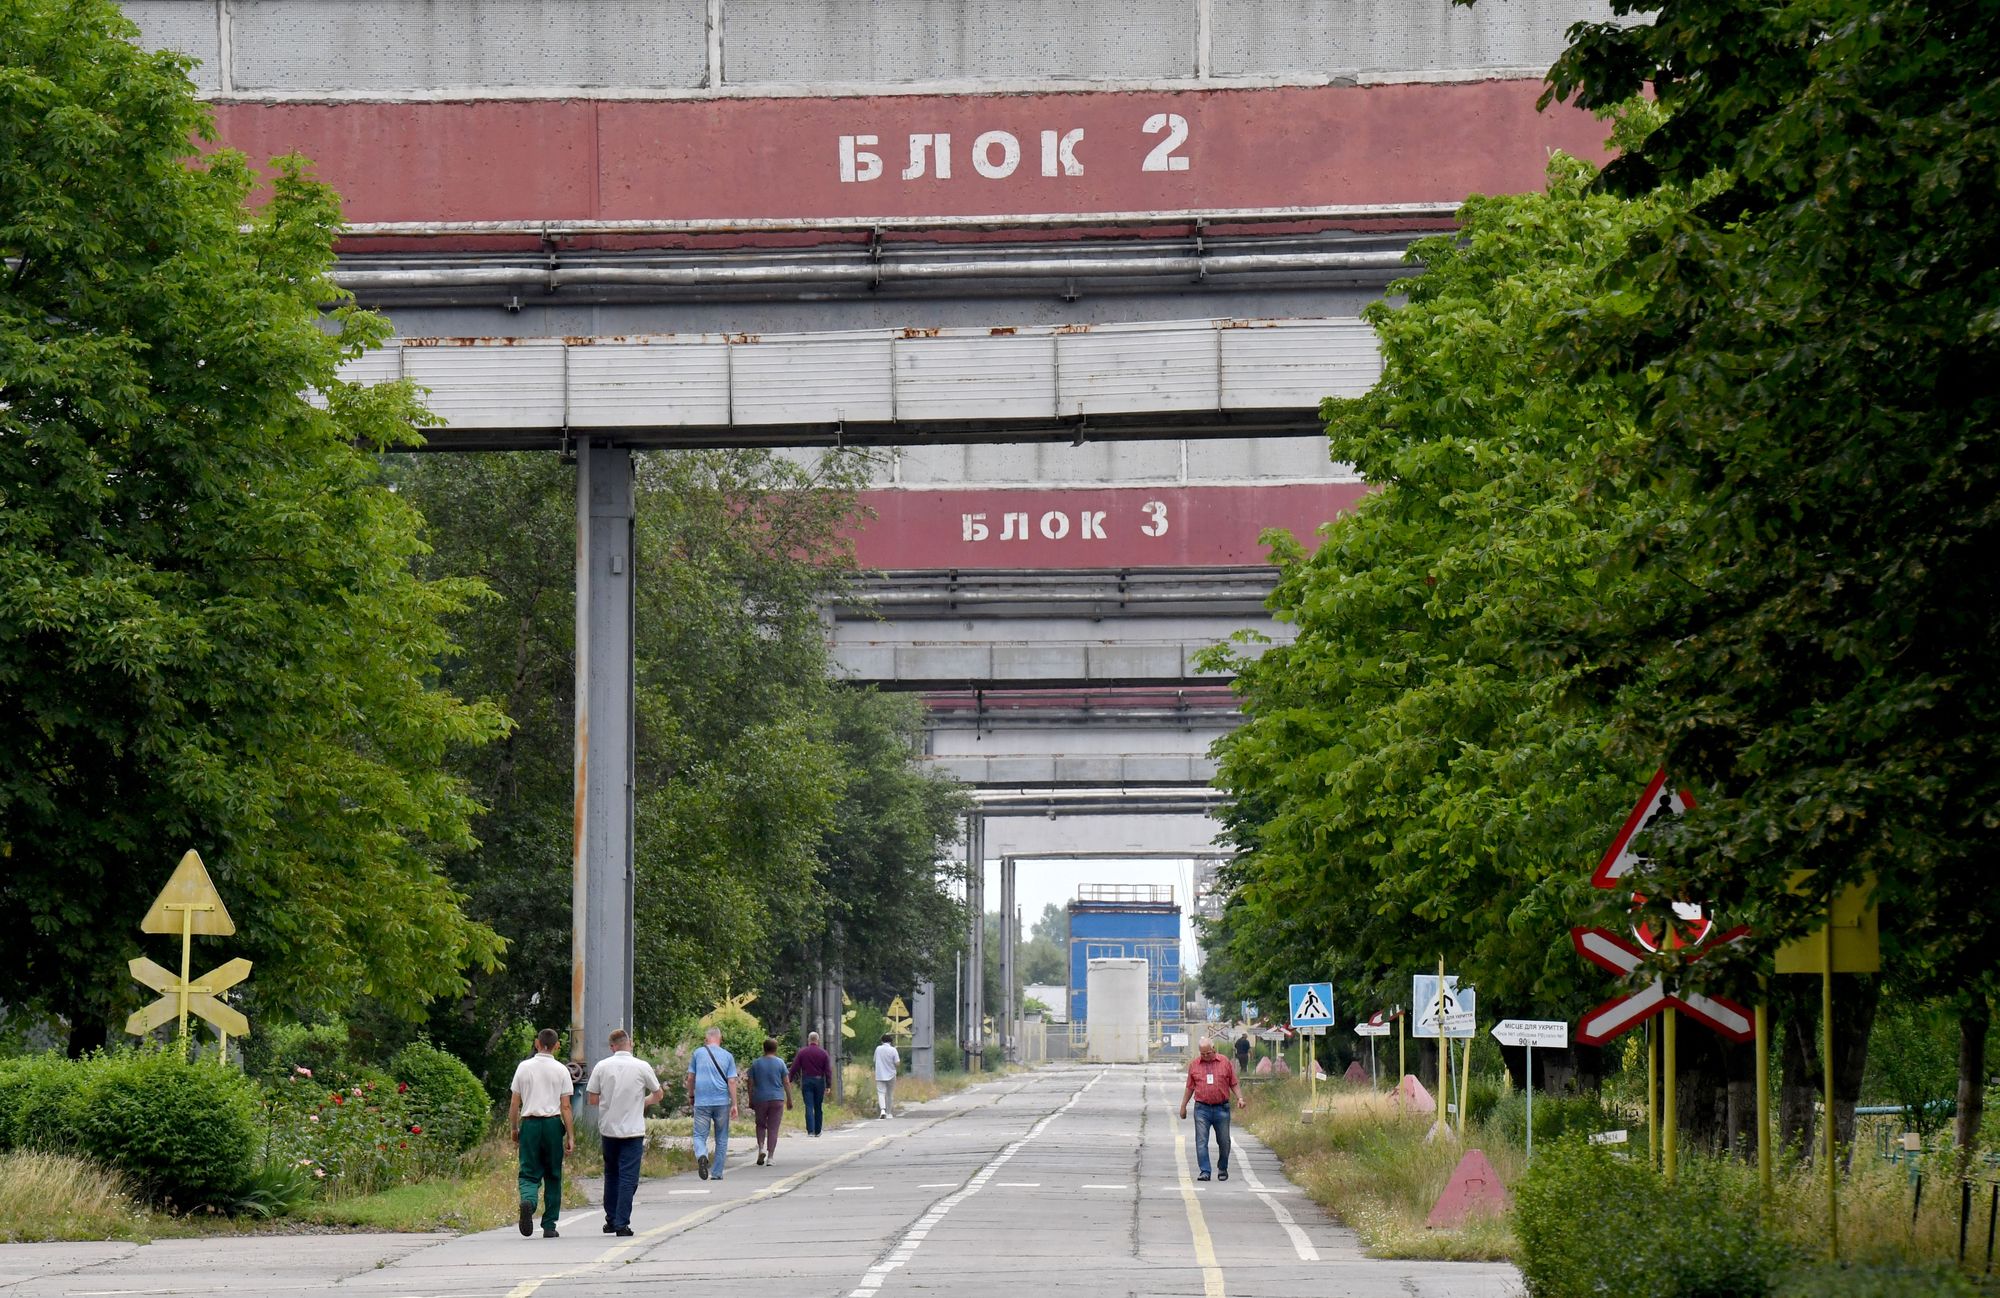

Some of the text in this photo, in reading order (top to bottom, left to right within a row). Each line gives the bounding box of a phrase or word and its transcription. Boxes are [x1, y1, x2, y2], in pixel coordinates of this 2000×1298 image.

[839, 114, 1189, 182] БЛОК 2
[962, 501, 1169, 541] БЛОК 3
